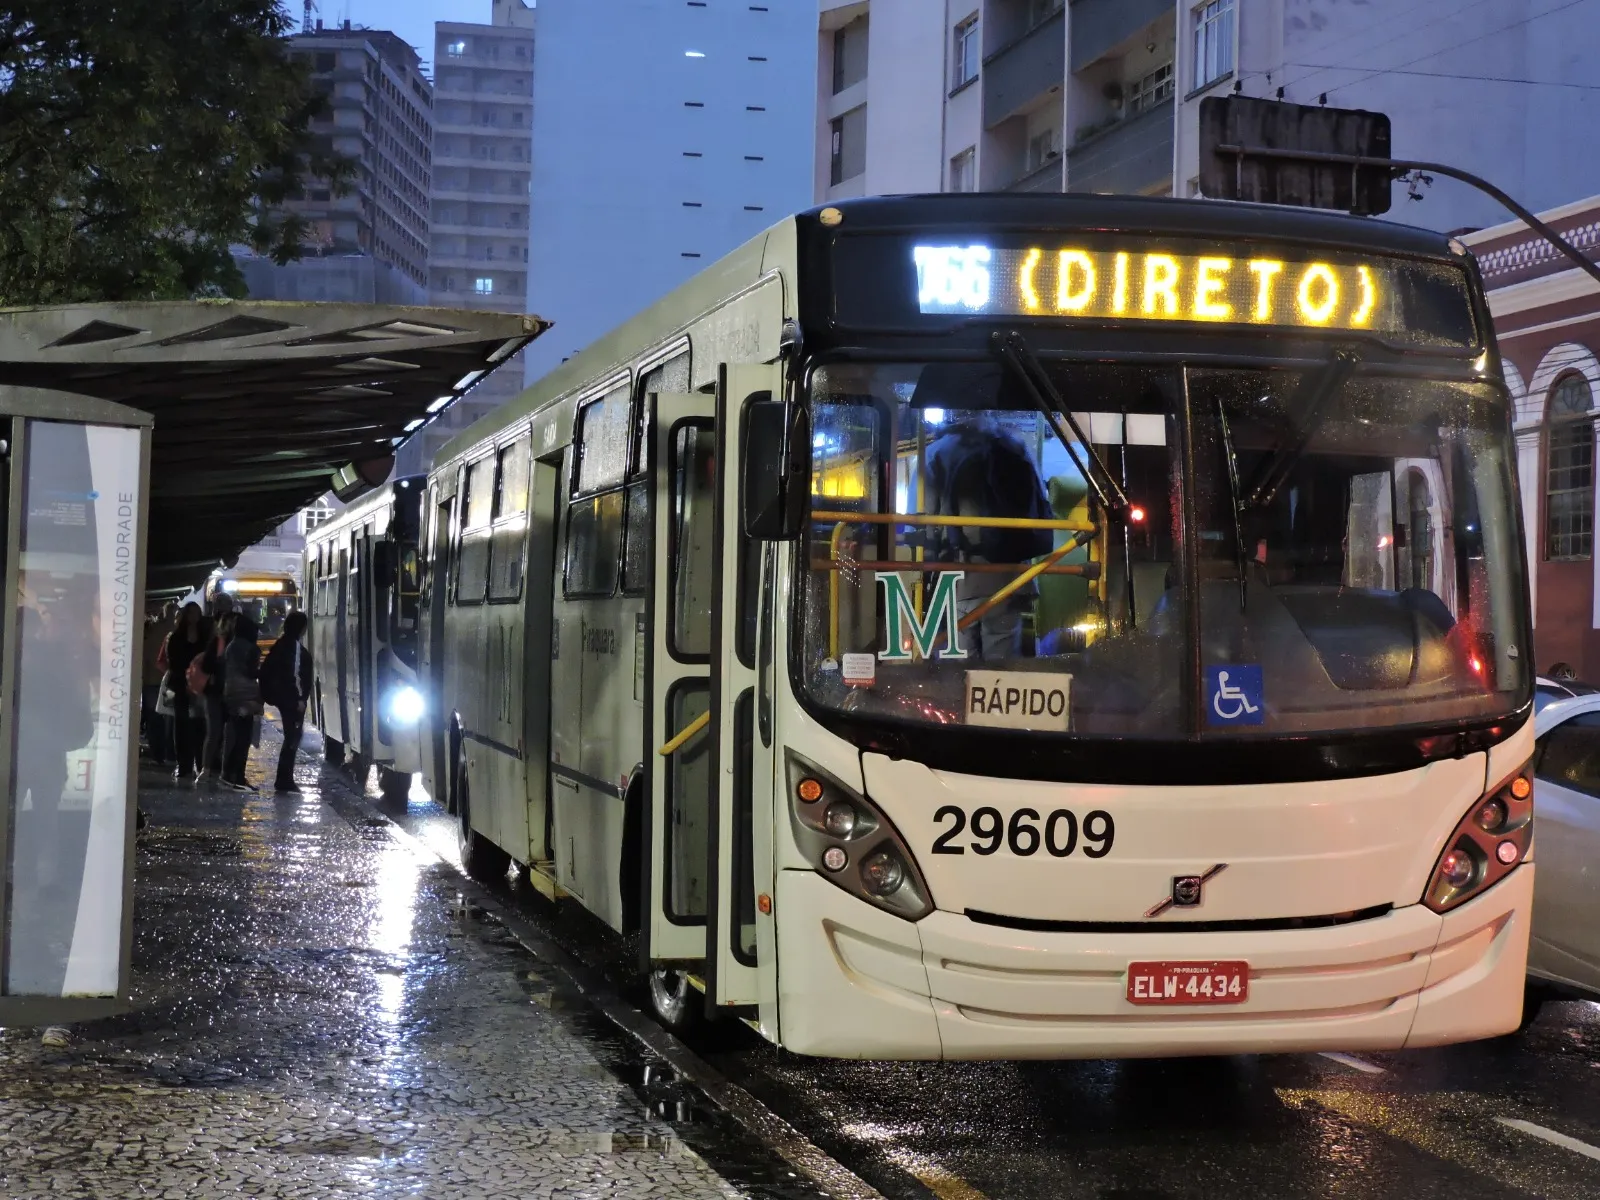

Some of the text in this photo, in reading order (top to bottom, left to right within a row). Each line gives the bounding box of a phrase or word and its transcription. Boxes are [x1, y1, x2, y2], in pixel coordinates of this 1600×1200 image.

[108, 491, 133, 740] PRAÇA SANTOS ANDRADE
[875, 570, 968, 661] M
[970, 679, 1066, 718] RÁPIDO
[931, 805, 1115, 859] 29609
